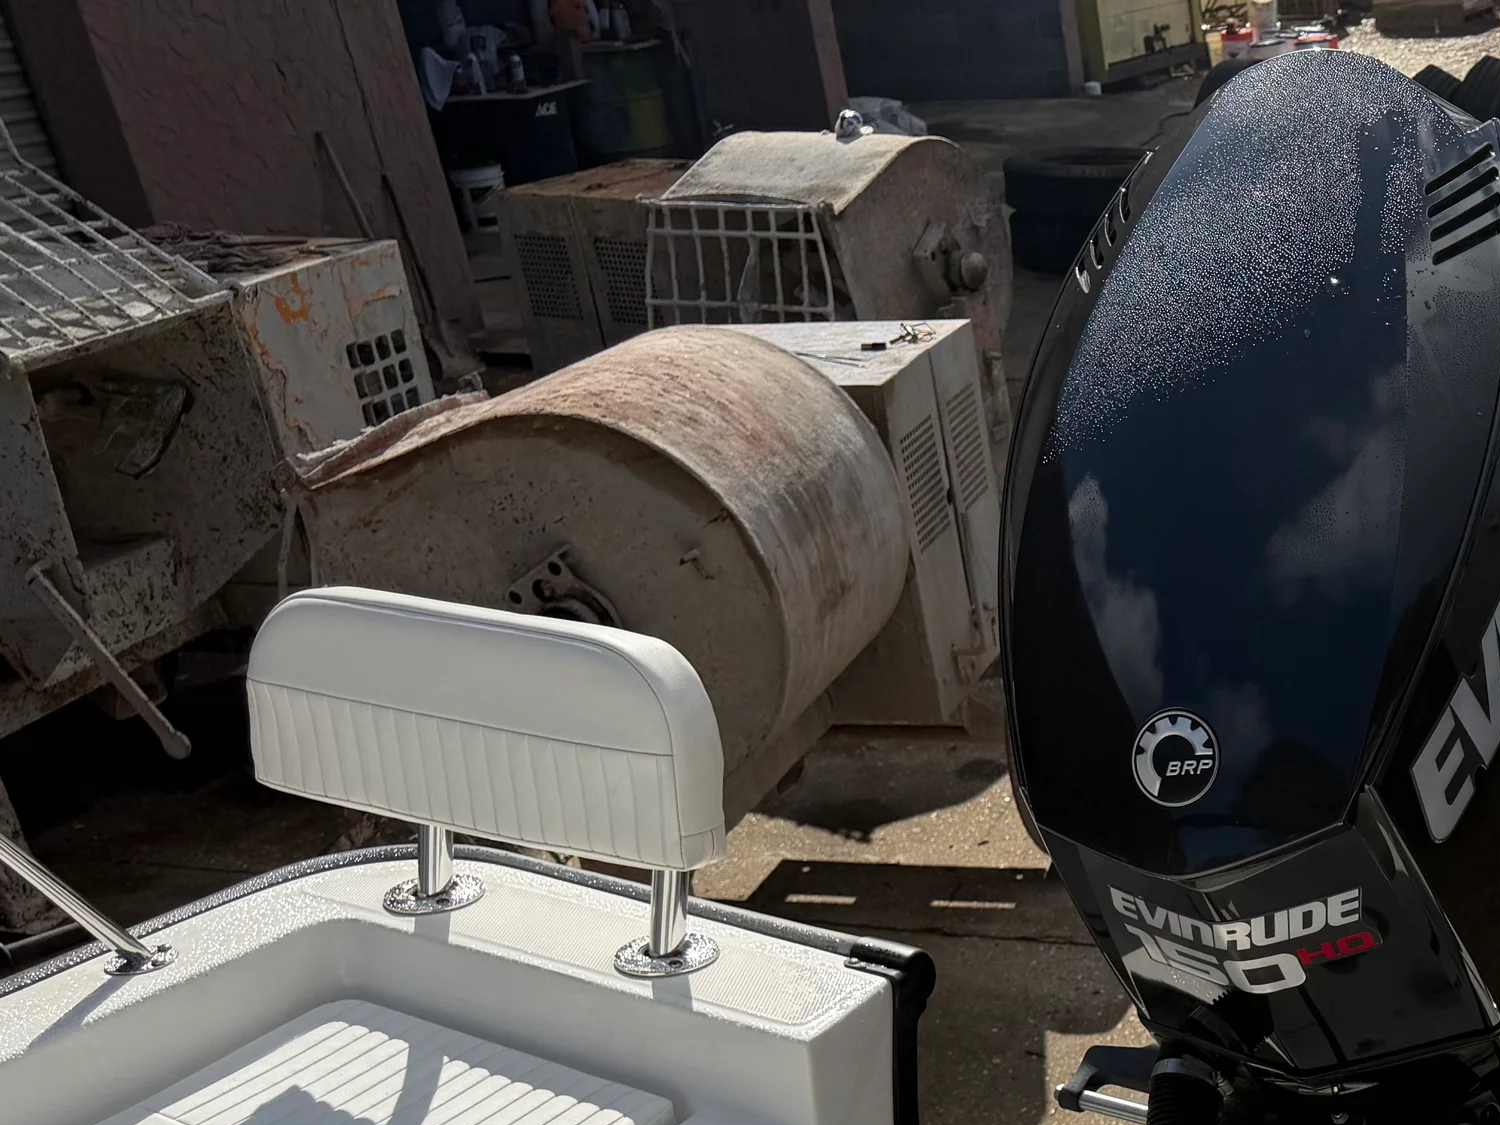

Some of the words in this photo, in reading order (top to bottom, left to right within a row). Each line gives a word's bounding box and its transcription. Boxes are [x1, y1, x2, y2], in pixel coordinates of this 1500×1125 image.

[535, 101, 557, 117] ACE
[1165, 758, 1214, 776] BRP
[1110, 887, 1361, 950] EVINRUDE
[1124, 923, 1307, 994] 150
